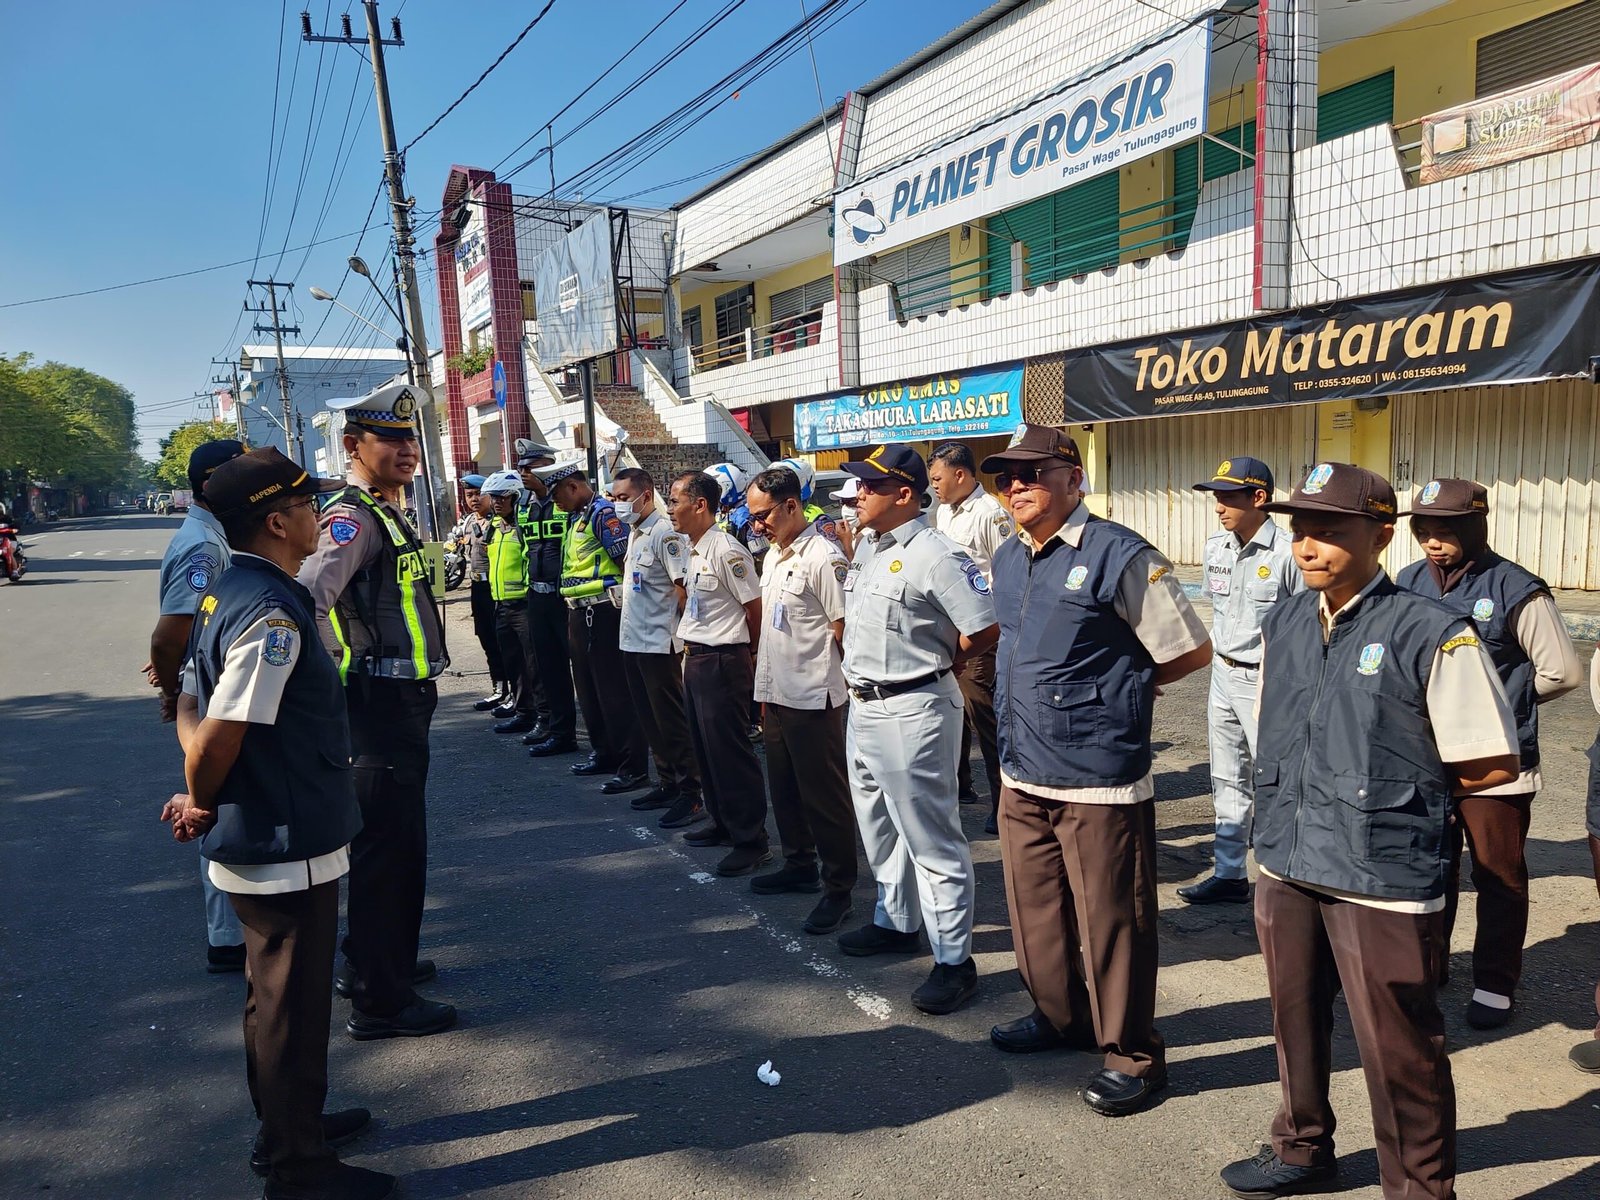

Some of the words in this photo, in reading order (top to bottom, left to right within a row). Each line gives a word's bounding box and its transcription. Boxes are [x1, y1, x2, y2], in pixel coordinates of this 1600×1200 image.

[890, 138, 1006, 223] PLANET
[1010, 63, 1174, 177] GROSIR
[1479, 114, 1541, 144] SUPER
[1062, 160, 1090, 178] Pasar
[1092, 148, 1120, 166] Wage
[1124, 117, 1197, 153] Tulungagung
[1133, 339, 1228, 391] Toko
[1240, 301, 1513, 379] Mataram
[1294, 381, 1313, 390] TELP
[1319, 374, 1371, 389] 0355-324620
[1381, 371, 1397, 381] WA
[1402, 364, 1466, 379] 08155634994
[1154, 396, 1174, 405] PASAR
[1175, 394, 1193, 403] WAGE
[1216, 386, 1269, 399] TULUNGAGUNG
[826, 404, 913, 433] TAKASIMURA
[920, 392, 1009, 423] LARASATI
[249, 483, 283, 503] BAPENDA
[1207, 564, 1232, 576] ARDIAN
